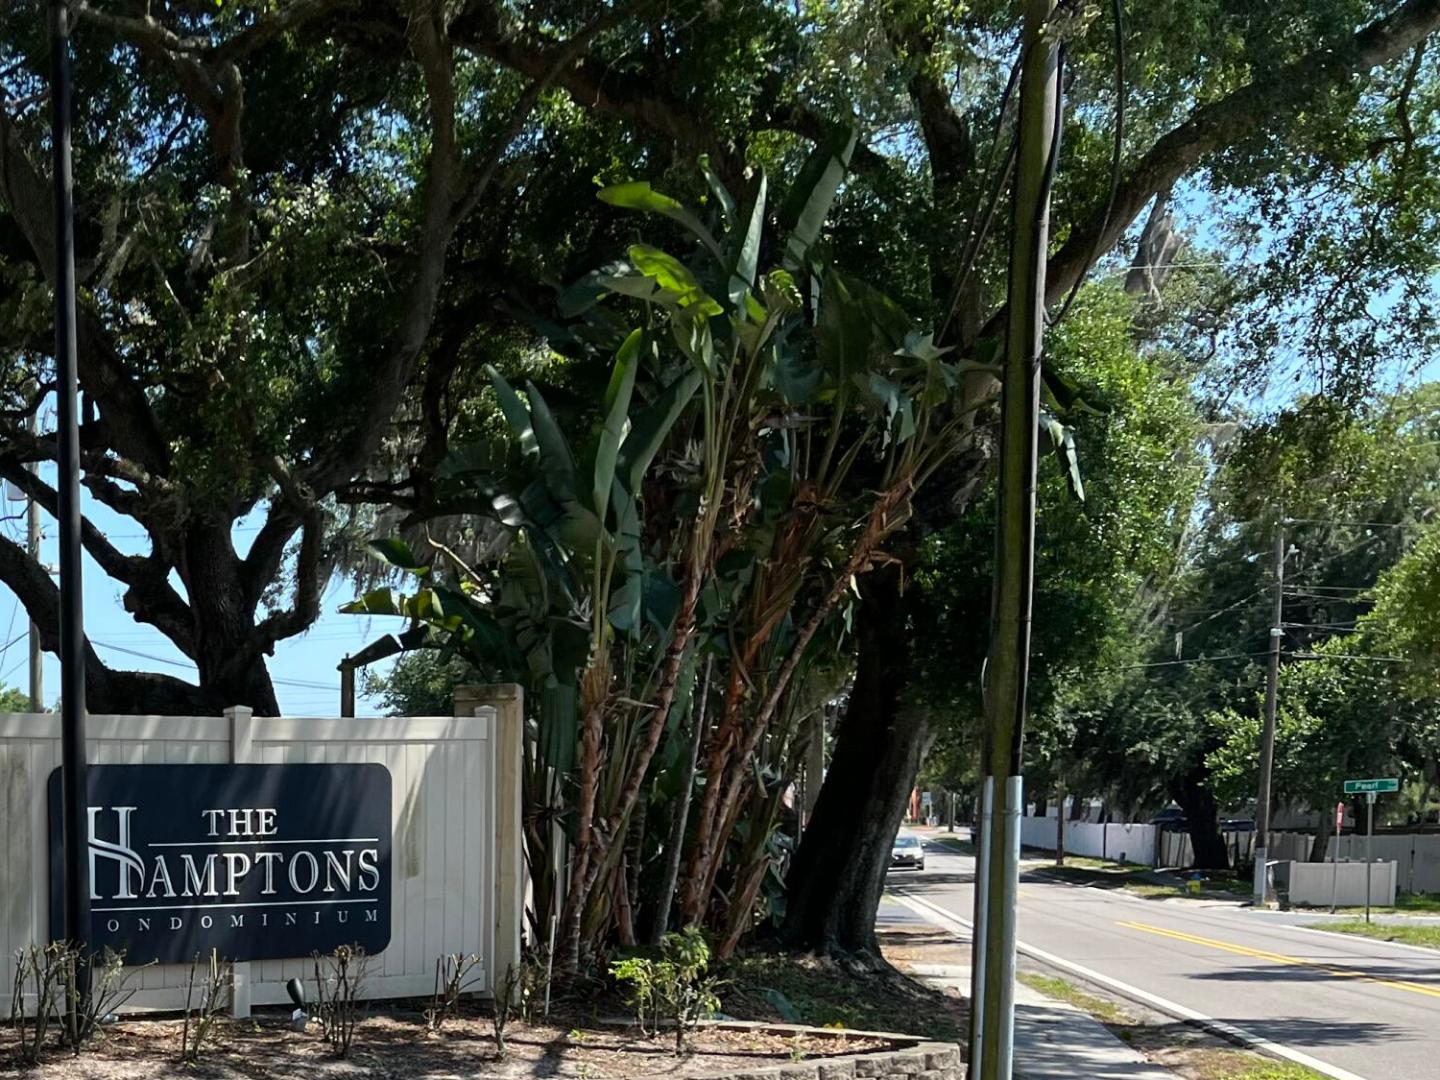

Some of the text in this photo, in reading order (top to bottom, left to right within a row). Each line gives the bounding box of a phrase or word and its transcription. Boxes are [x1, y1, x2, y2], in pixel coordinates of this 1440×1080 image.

[202, 808, 278, 836] THE
[87, 806, 380, 899] HAMPTONS
[106, 909, 378, 933] ONDOMINIUM
